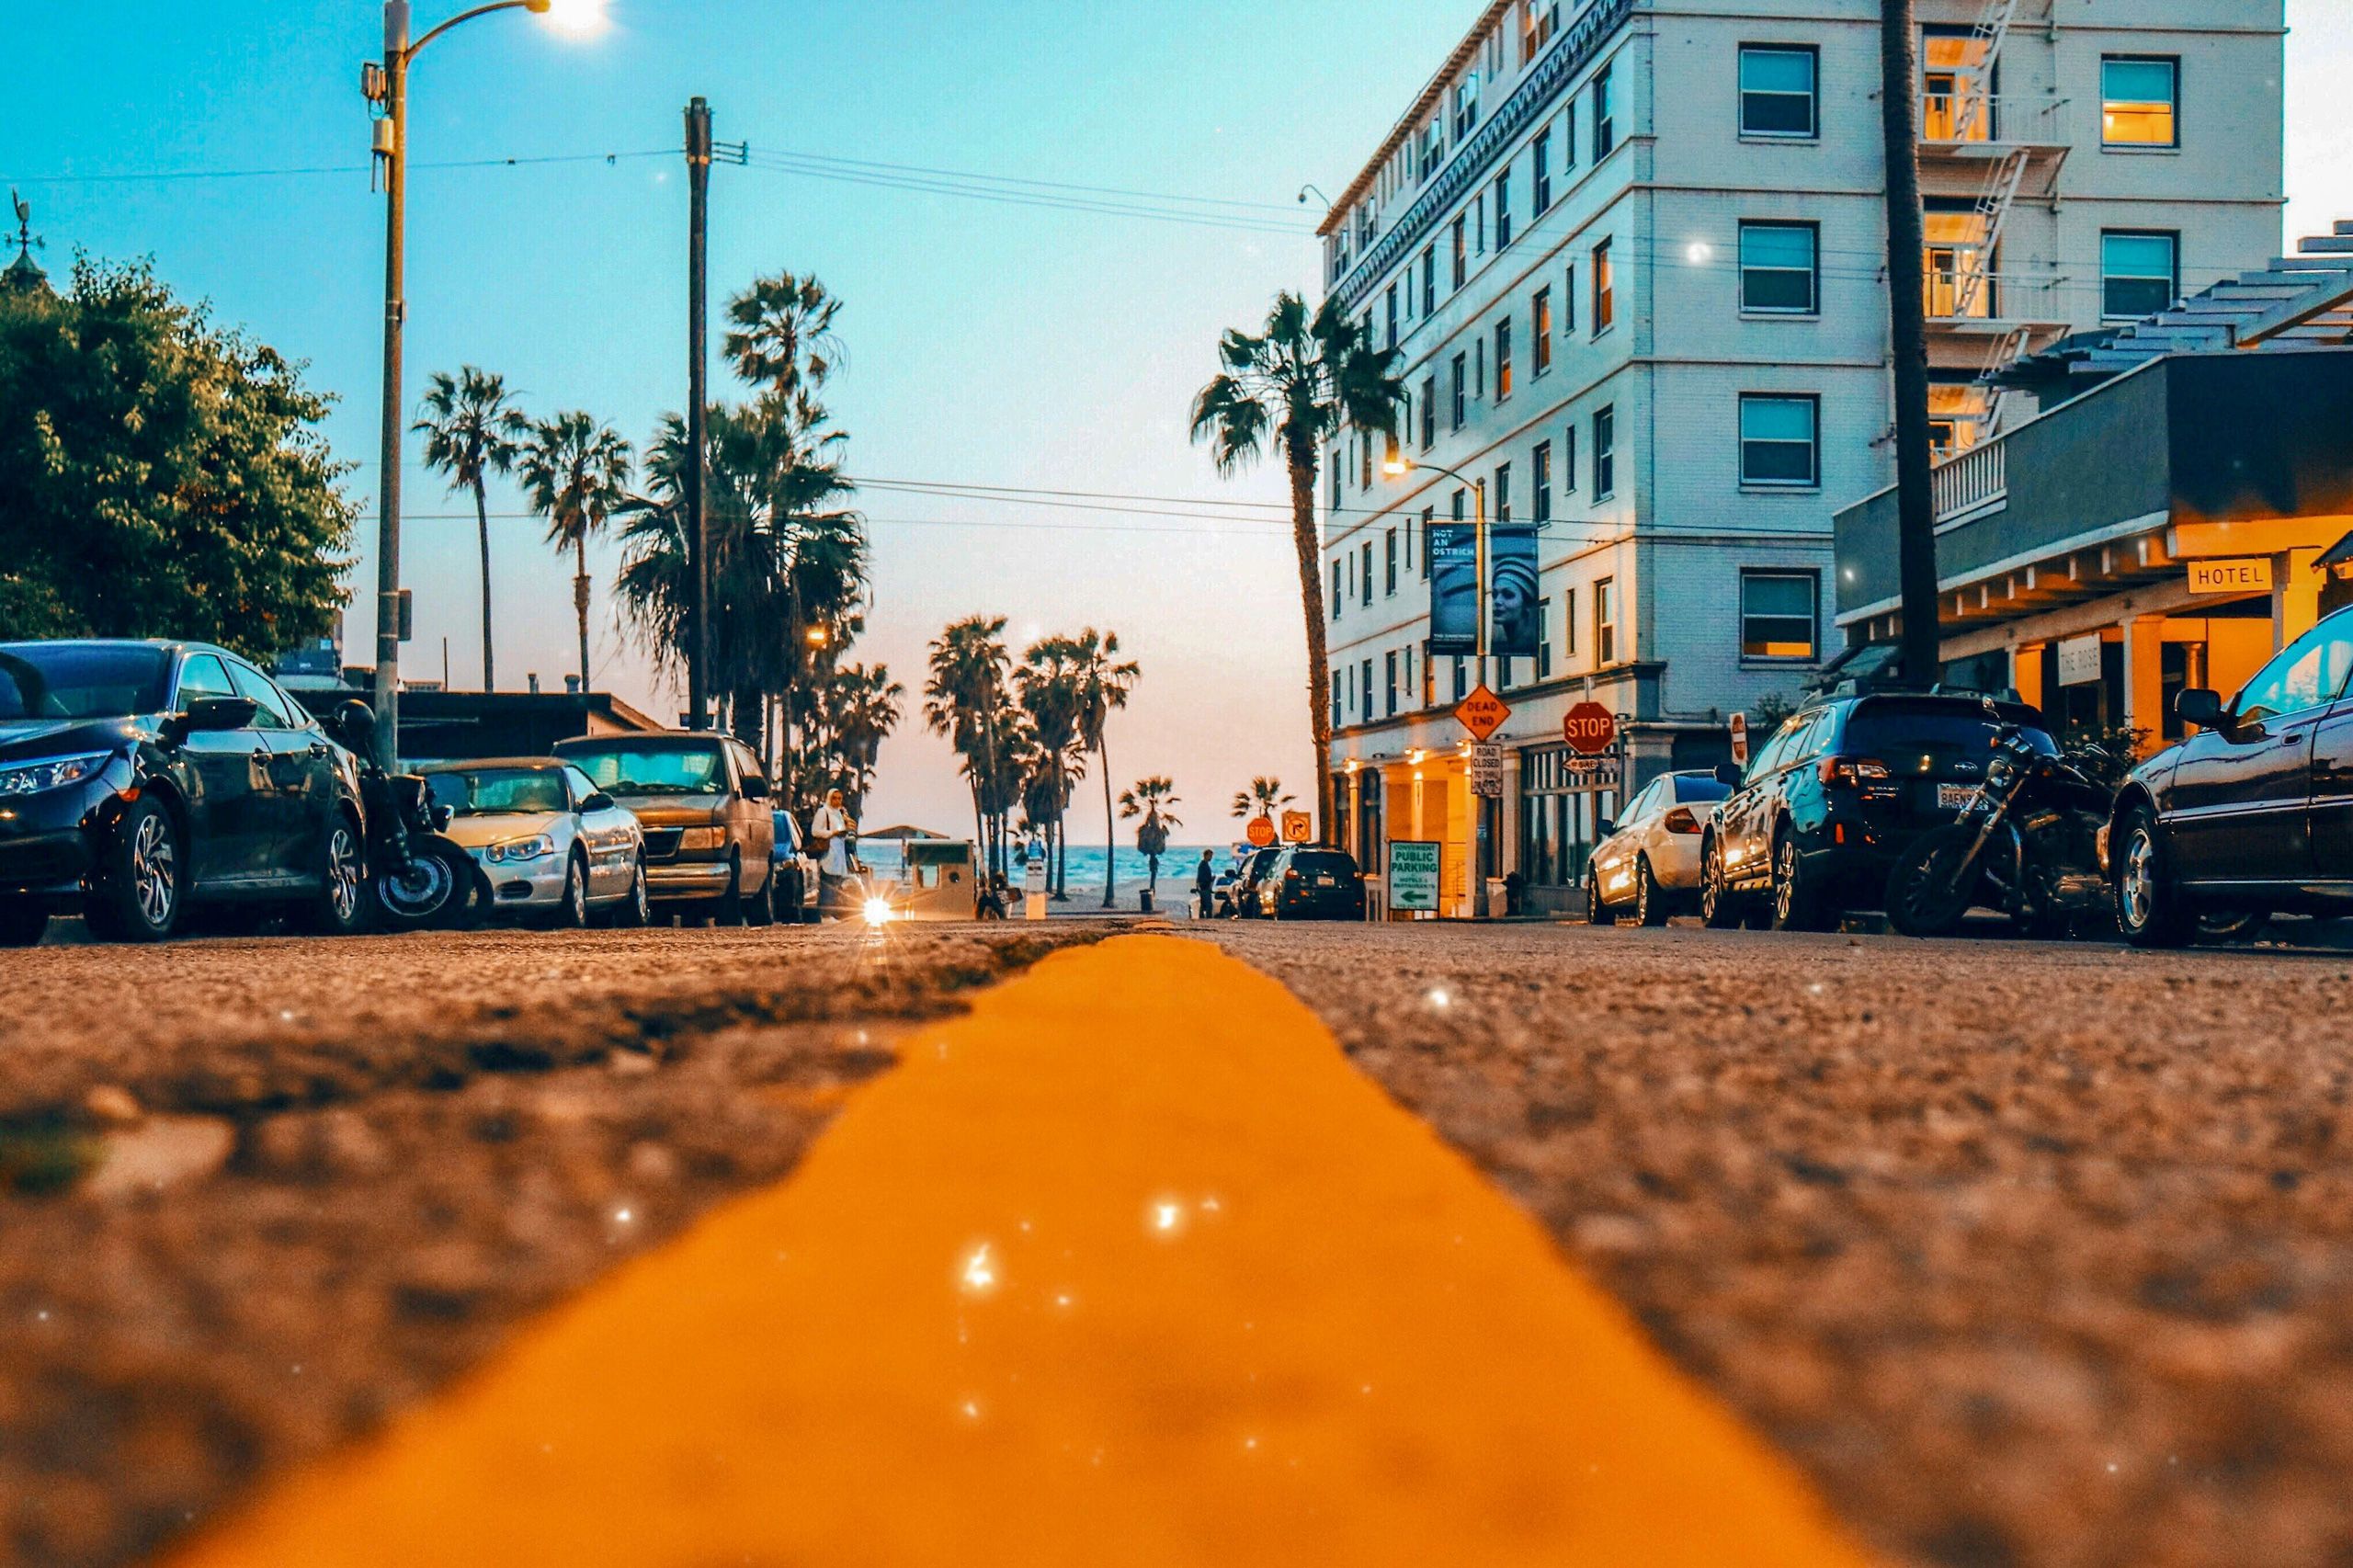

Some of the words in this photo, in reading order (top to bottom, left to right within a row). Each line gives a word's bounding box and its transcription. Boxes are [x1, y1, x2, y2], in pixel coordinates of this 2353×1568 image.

[1432, 529, 1453, 538] NOT
[1433, 539, 1449, 547] AN
[1432, 548, 1474, 556] OSTRICH
[2199, 568, 2264, 585] HOTEL
[1467, 702, 1497, 711] DEAD
[1472, 717, 1494, 726] END
[1567, 718, 1610, 737] STOP
[1476, 747, 1496, 756] ROAD
[1472, 758, 1499, 767] CLOSED
[1248, 826, 1272, 837] STOP
[1395, 851, 1434, 861] PUBLIC
[1391, 862, 1438, 873] PARKING
